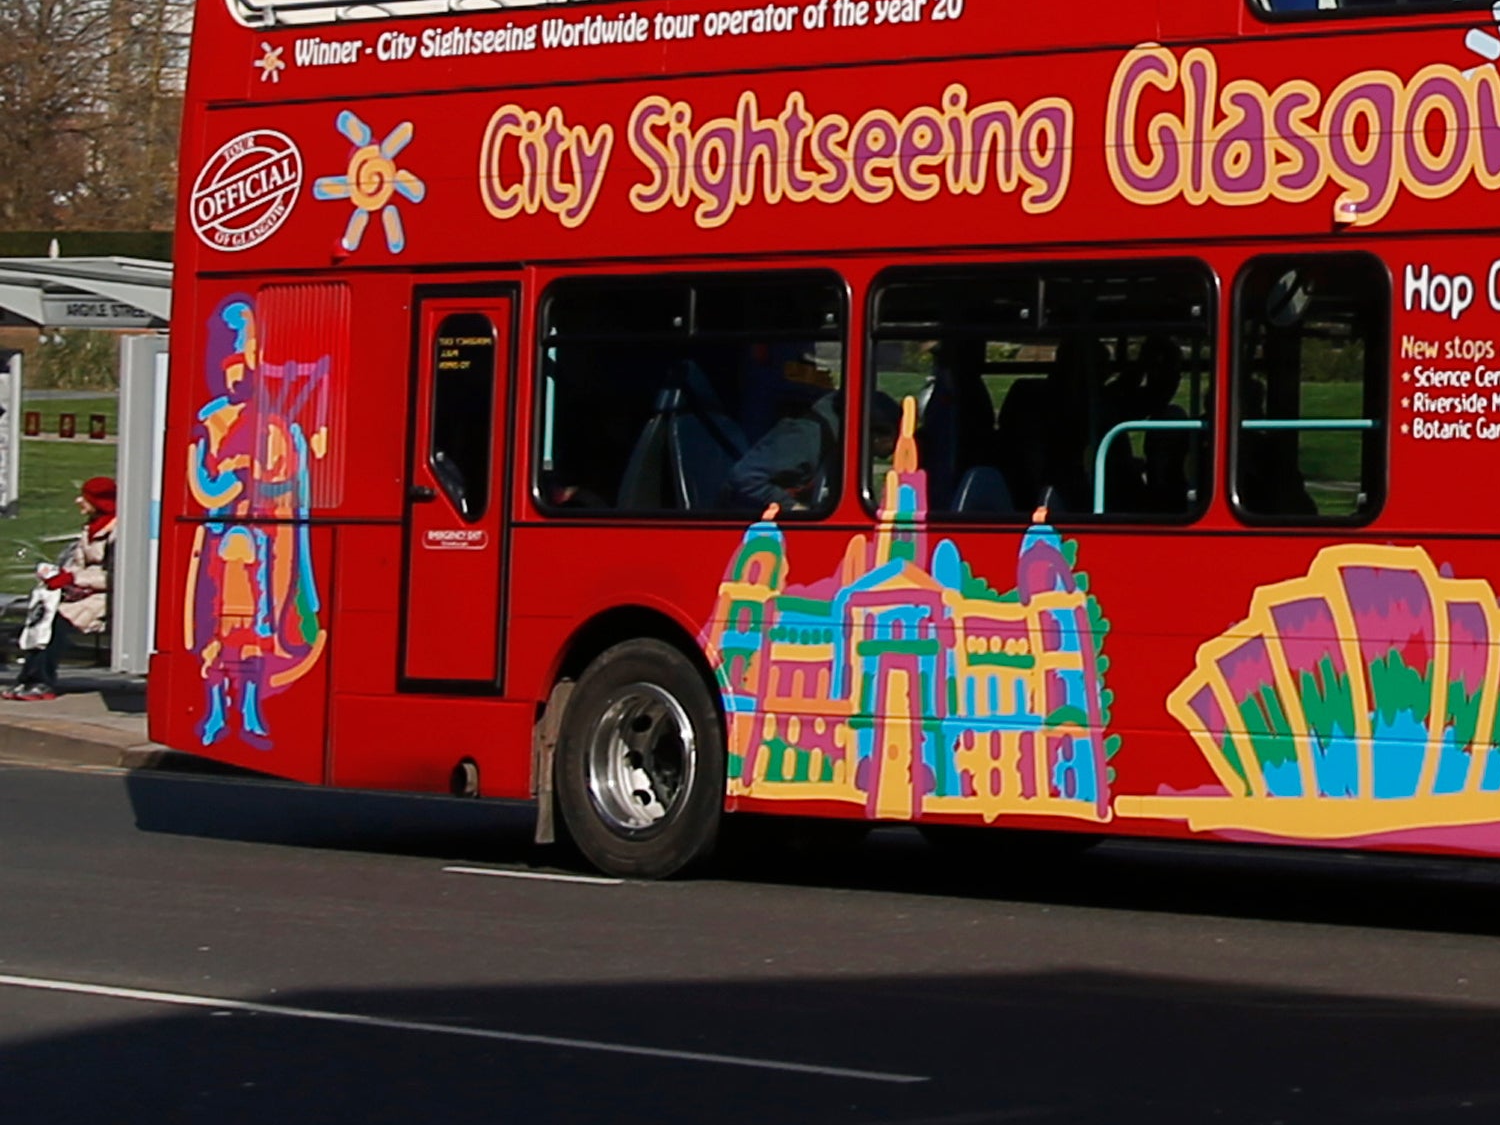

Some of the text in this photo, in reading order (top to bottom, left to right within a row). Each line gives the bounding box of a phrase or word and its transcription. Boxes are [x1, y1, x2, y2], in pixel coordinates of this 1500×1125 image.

[295, 38, 362, 67] Winner
[376, 31, 417, 62] City
[420, 22, 537, 59] Sightseeing
[542, 12, 648, 48] Worldwide
[654, 12, 700, 41] tour
[703, 2, 799, 37] operator
[222, 136, 256, 163] TOUR
[480, 103, 613, 229] City
[627, 83, 1074, 229] Sightseeing
[199, 158, 296, 222] OFFICIAL
[213, 200, 286, 247] OF GLASGOW
[1404, 263, 1474, 320] Hop
[66, 303, 108, 317] ARGYLE
[1401, 336, 1439, 359] New
[1444, 336, 1495, 362] stops
[1413, 366, 1471, 388] Science
[1413, 393, 1488, 414] Riverside
[1413, 418, 1472, 440] Botanic
